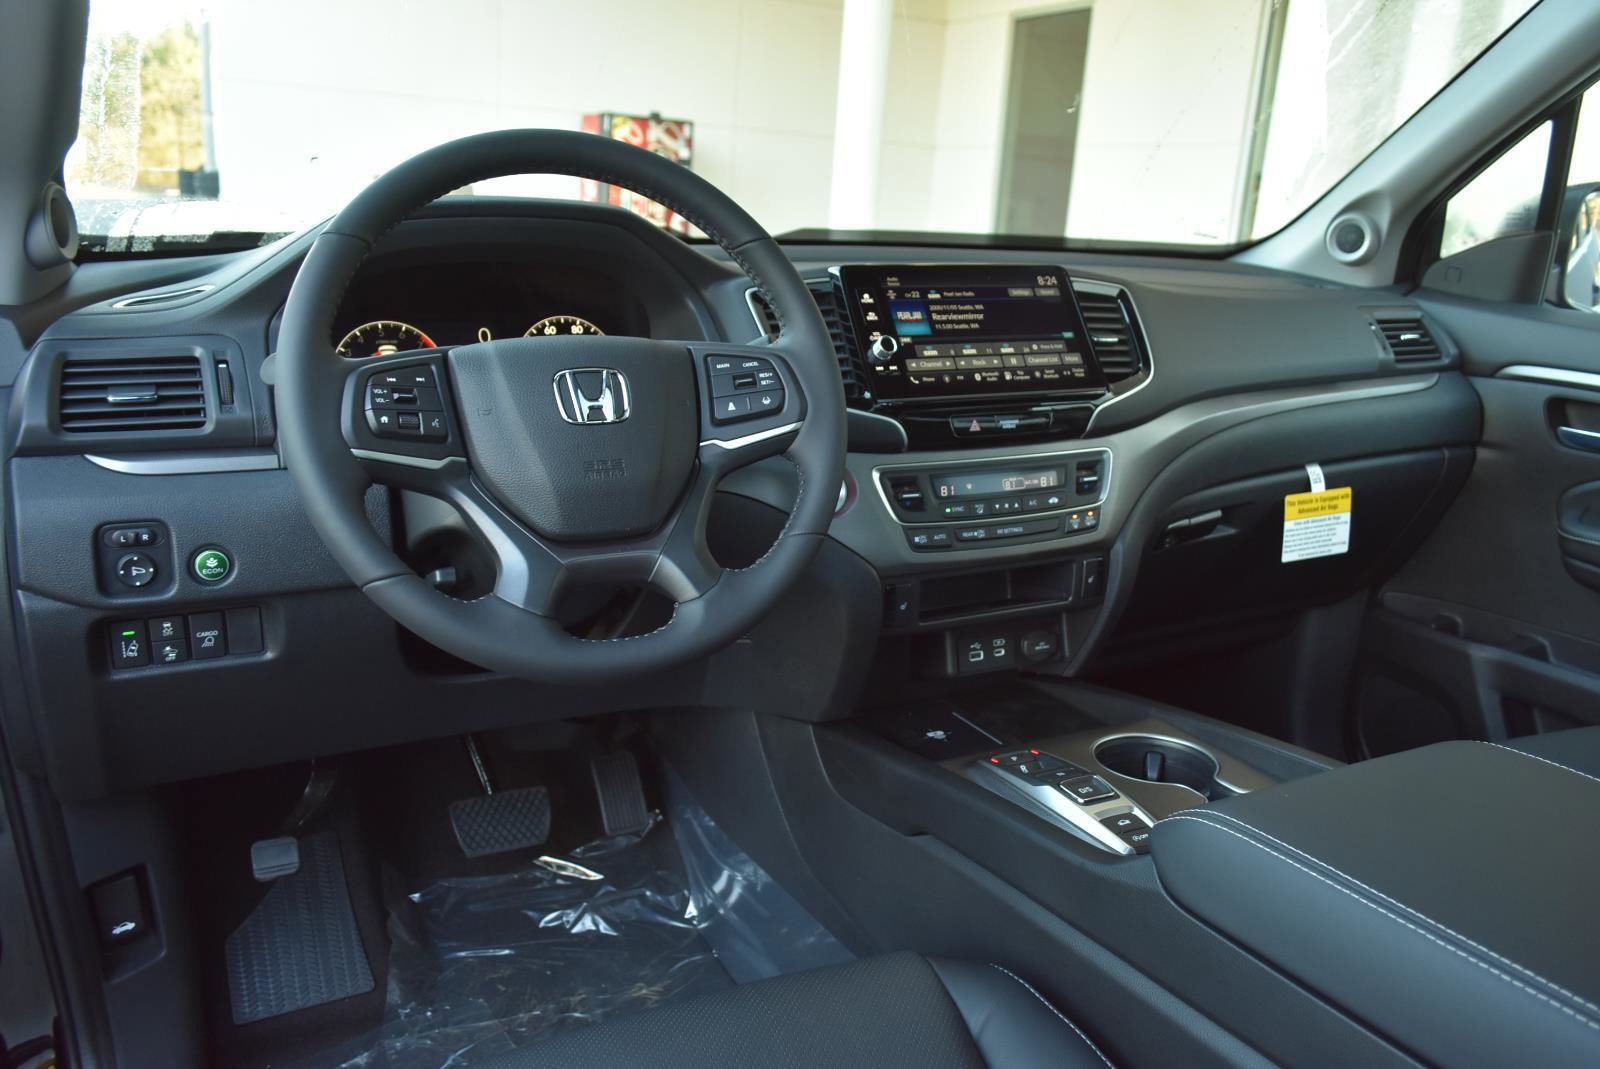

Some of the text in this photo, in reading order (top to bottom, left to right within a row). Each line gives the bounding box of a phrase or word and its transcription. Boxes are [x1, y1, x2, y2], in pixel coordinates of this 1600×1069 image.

[1036, 275, 1058, 286] 8:24
[931, 312, 984, 321] Rearviewmirror
[380, 330, 385, 338] 5
[544, 326, 557, 336] 60
[570, 325, 584, 334] 80
[478, 328, 492, 343] 0
[1040, 476, 1054, 487] 81
[940, 485, 955, 497] 81
[1020, 765, 1029, 773] R
